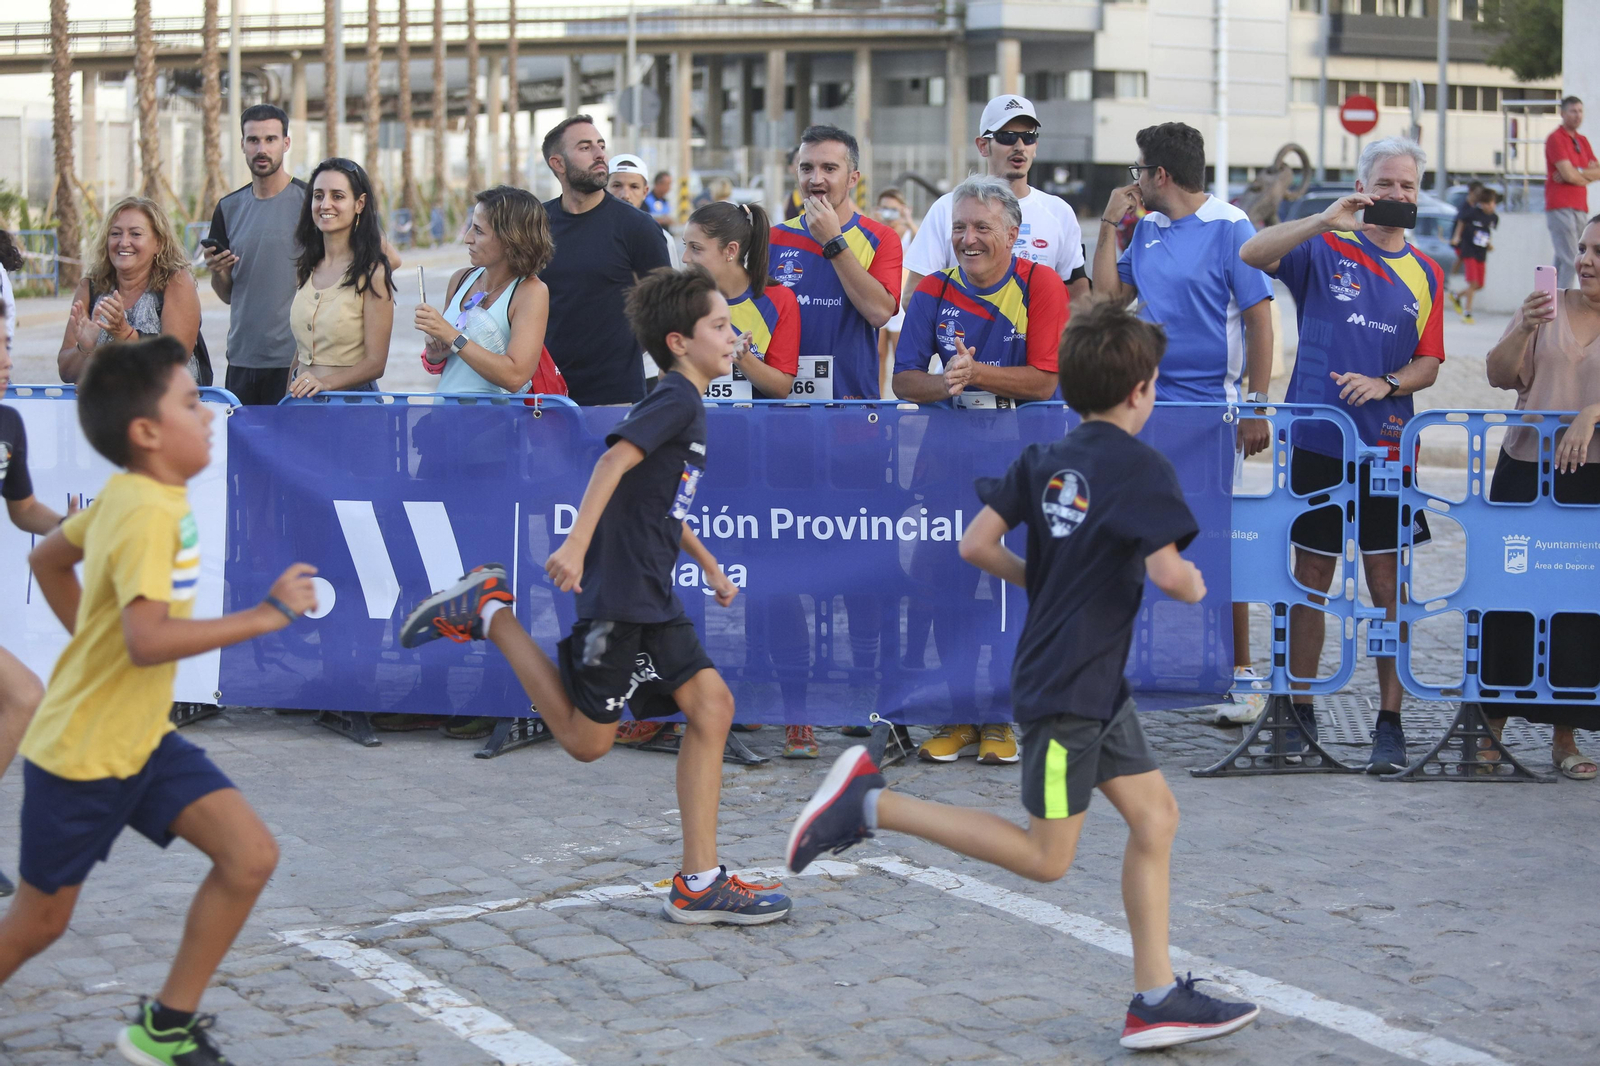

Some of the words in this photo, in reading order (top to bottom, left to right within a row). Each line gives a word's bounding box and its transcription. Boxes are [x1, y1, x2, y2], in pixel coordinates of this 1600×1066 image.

[812, 297, 842, 308] mupol
[1368, 320, 1397, 334] mupol
[789, 380, 815, 395] 66
[554, 503, 759, 539] Dción
[770, 506, 963, 541] Provincial
[1535, 561, 1552, 570] Área
[1554, 562, 1564, 570] de
